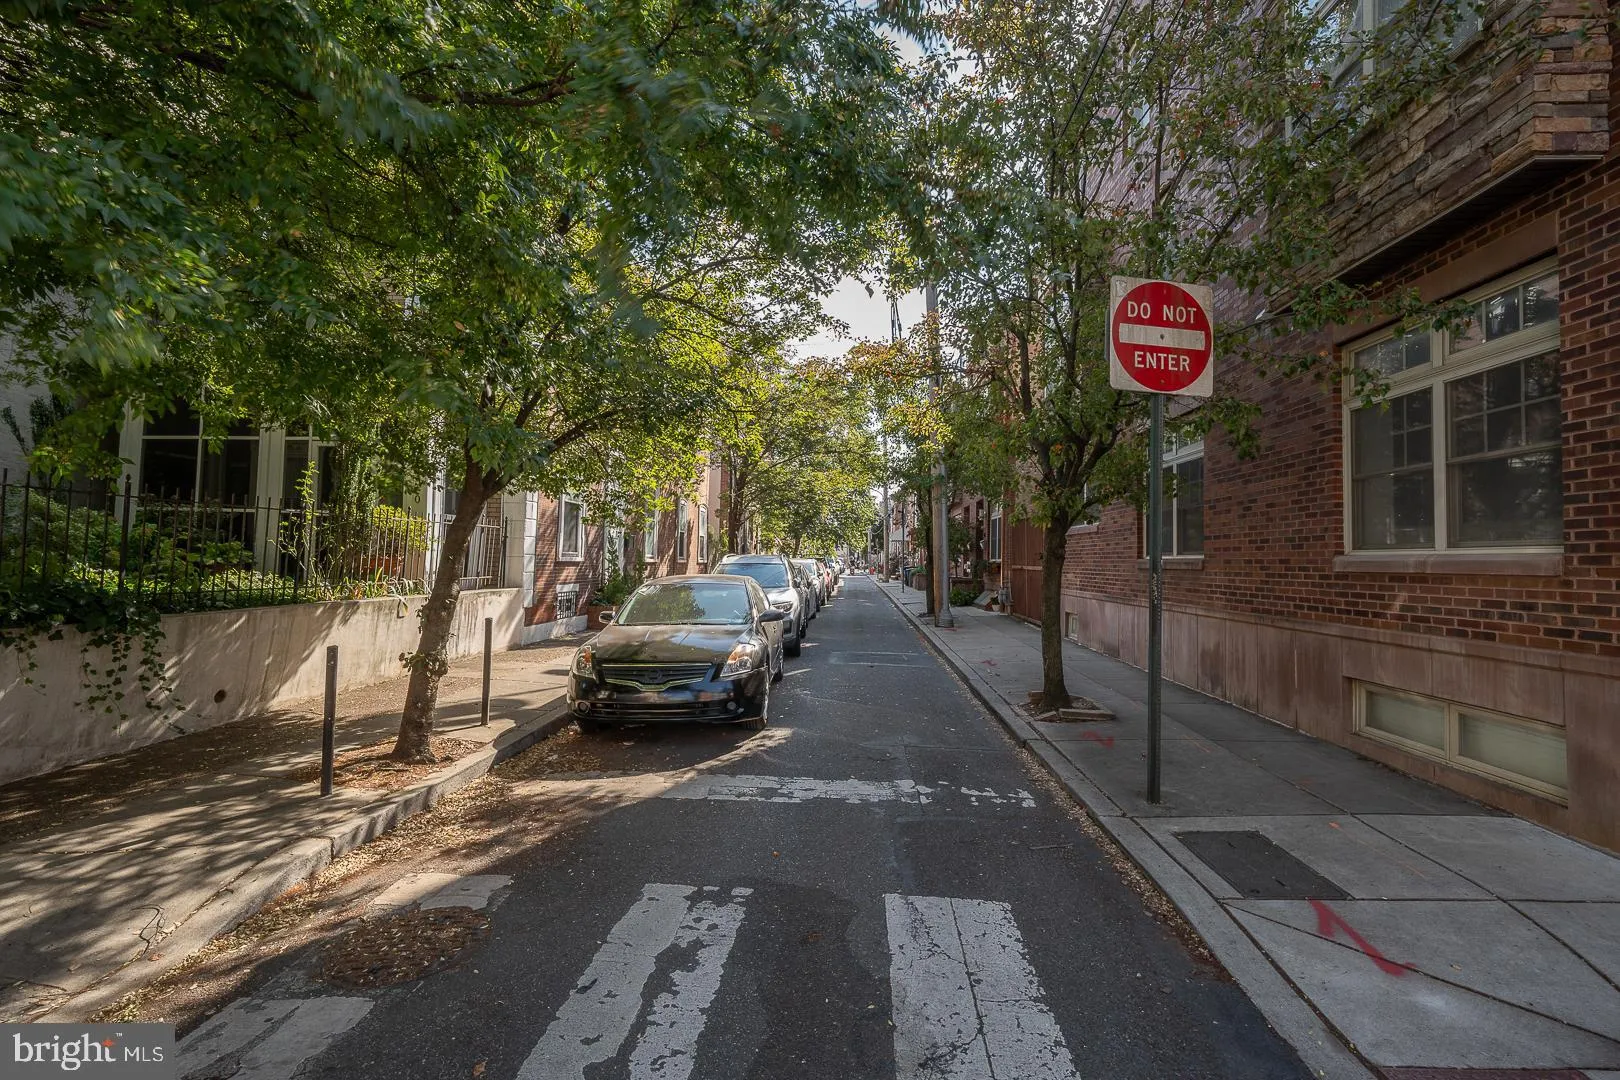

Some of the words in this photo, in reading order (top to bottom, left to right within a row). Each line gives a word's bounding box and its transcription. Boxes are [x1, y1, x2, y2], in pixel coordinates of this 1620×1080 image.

[1127, 301, 1151, 319] DO
[1163, 304, 1197, 323] NOT
[1134, 351, 1190, 372] ENTER
